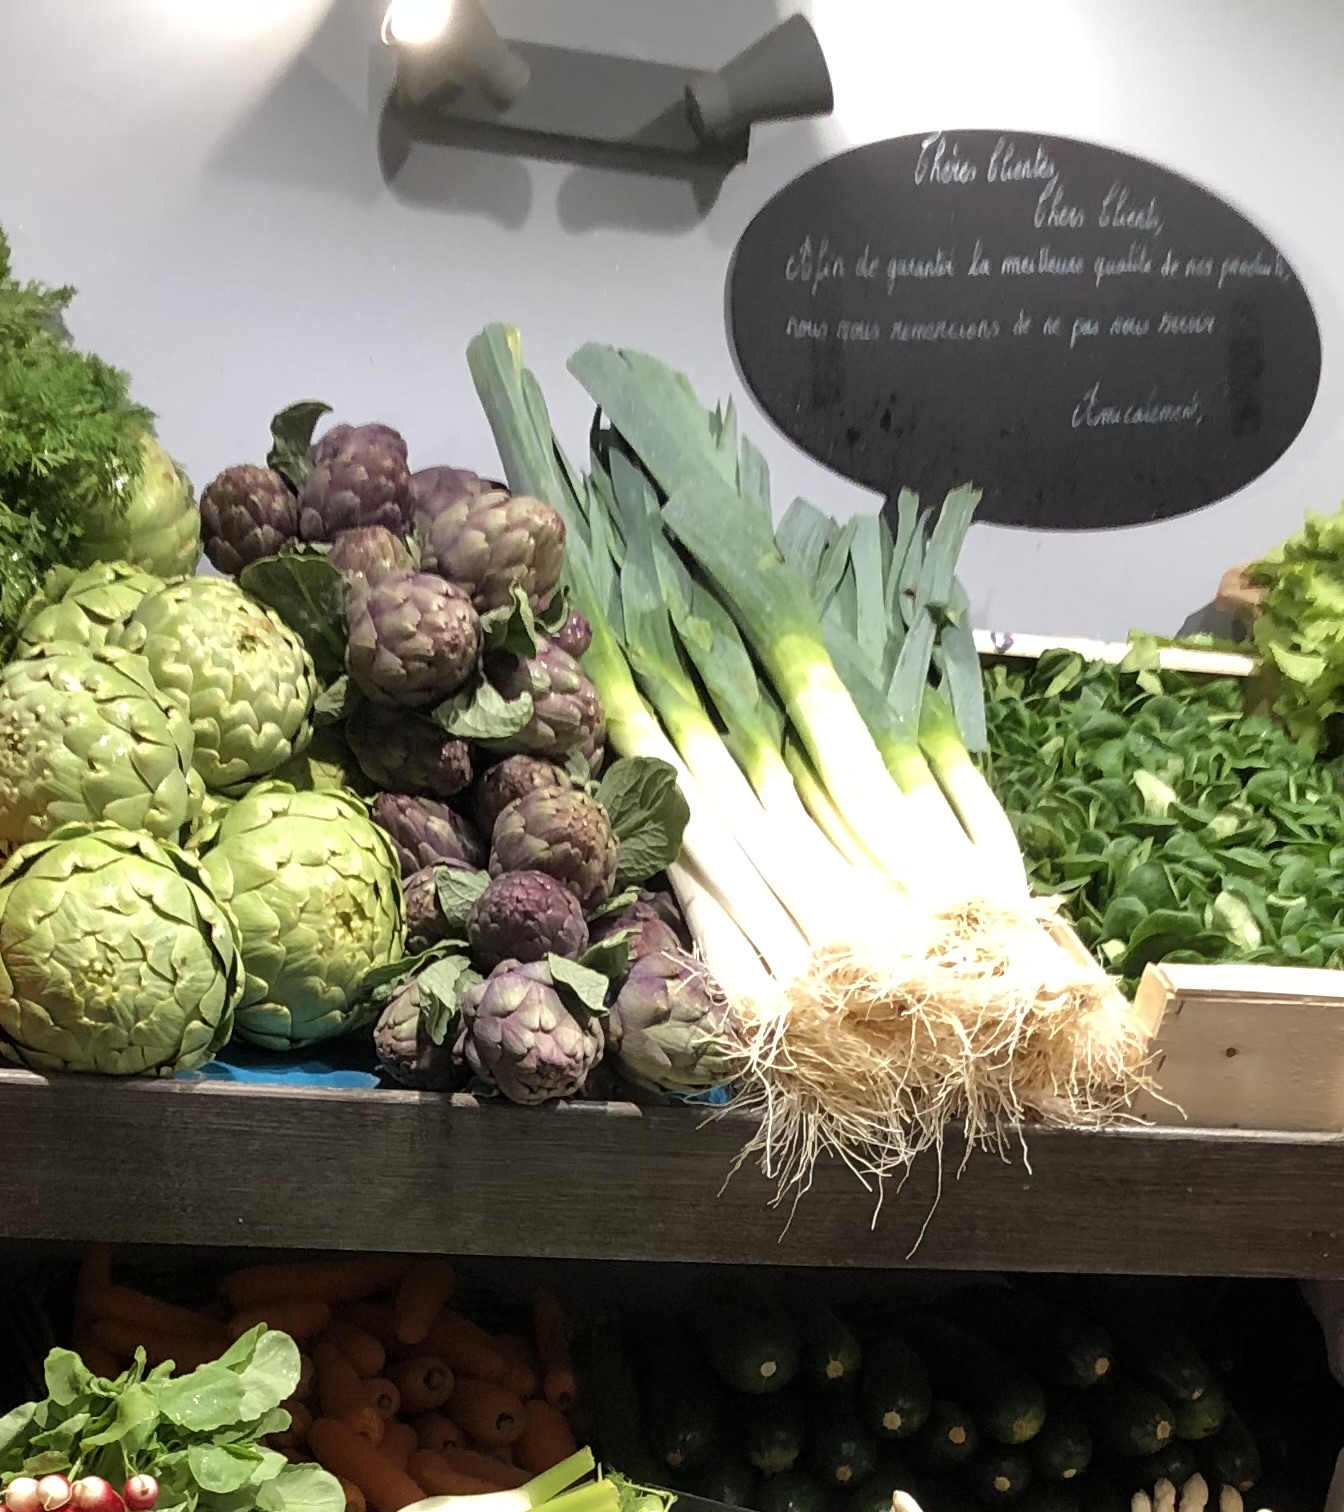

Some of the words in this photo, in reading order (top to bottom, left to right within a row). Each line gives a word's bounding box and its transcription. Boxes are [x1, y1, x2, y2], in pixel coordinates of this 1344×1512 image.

[855, 243, 880, 278] de
[1161, 248, 1179, 277] de
[1013, 307, 1032, 337] de
[1043, 315, 1061, 336] ne
